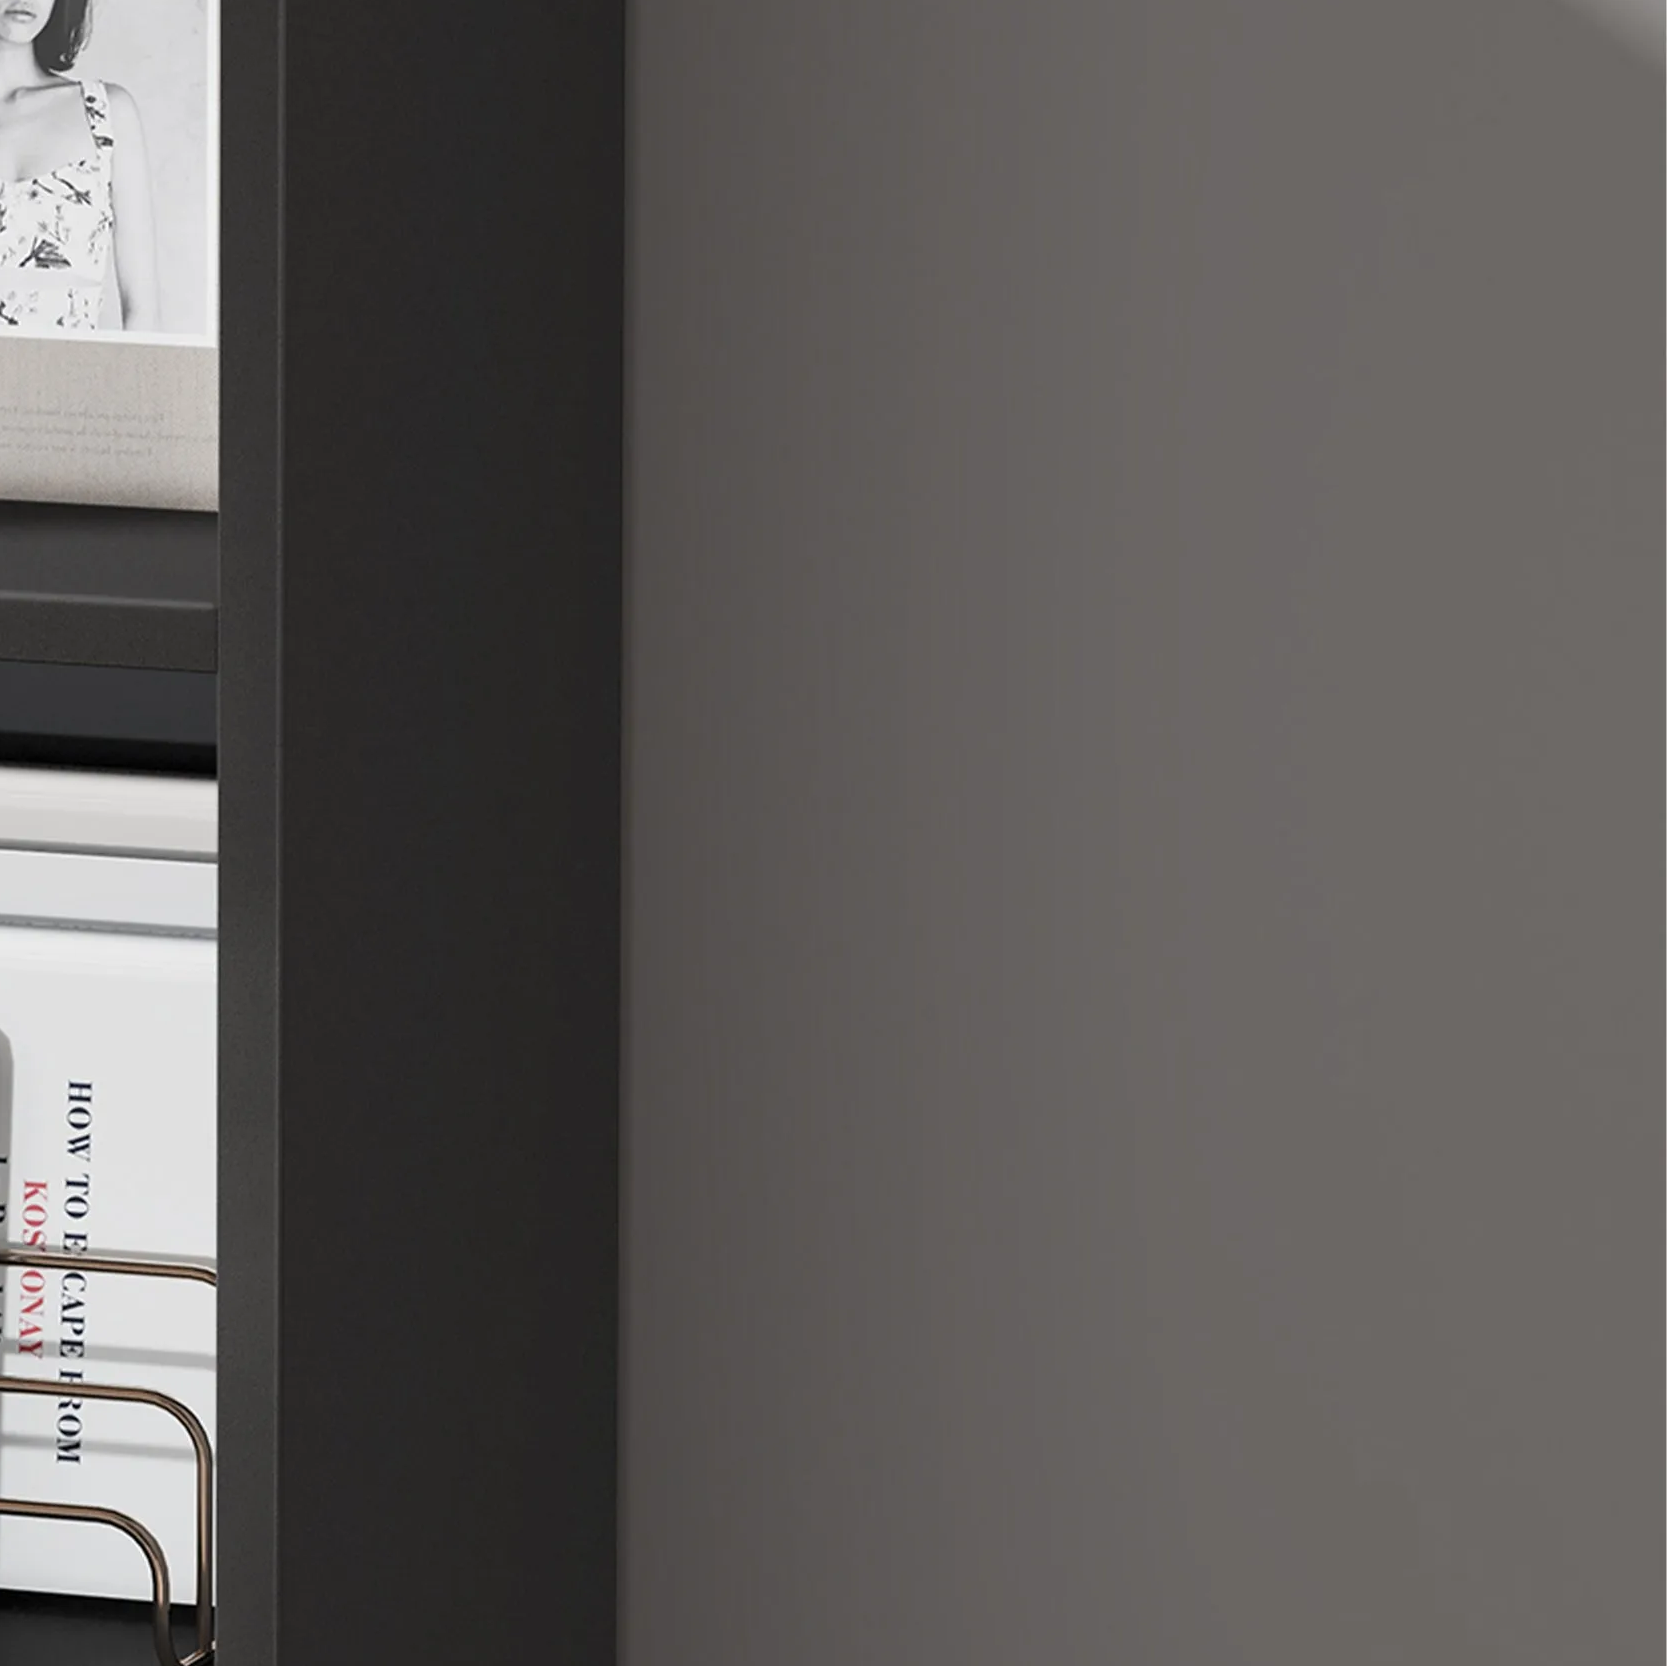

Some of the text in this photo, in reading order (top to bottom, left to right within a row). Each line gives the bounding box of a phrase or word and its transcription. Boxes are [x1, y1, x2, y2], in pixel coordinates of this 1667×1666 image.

[66, 1079, 93, 1163] HOW
[63, 1172, 90, 1219] TO
[19, 1179, 48, 1360] KOSONAY
[59, 1231, 88, 1359] ECAPE
